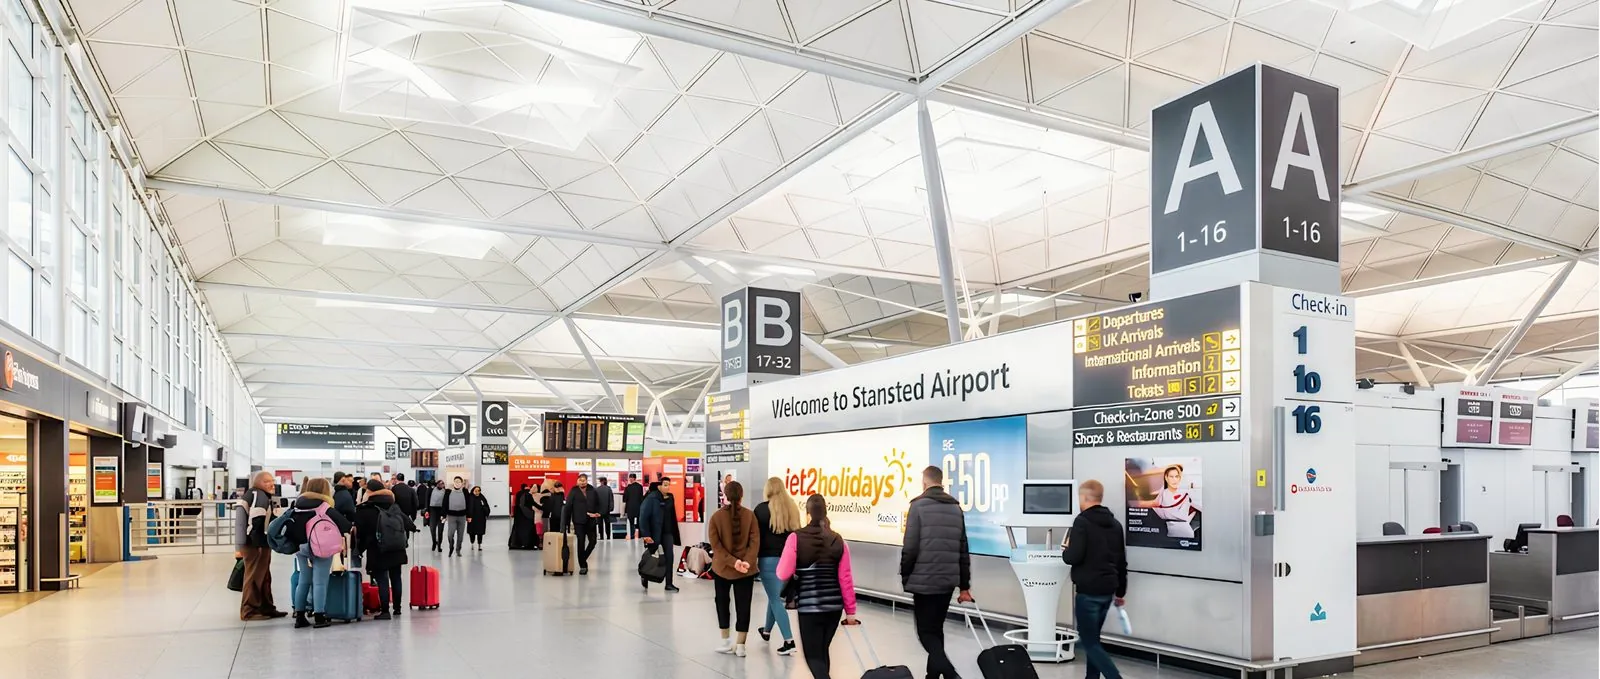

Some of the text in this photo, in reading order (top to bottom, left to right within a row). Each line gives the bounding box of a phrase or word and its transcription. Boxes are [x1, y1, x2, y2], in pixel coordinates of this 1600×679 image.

[1164, 100, 1243, 215] A
[1270, 91, 1331, 202] A
[1177, 219, 1227, 253] 1-16
[1282, 215, 1321, 244] 1-16
[1102, 306, 1164, 330] Departures
[1291, 293, 1348, 317] Check-in
[724, 298, 742, 350] B
[755, 295, 793, 347] B
[1103, 325, 1164, 347] UK Arrivals
[1293, 325, 1308, 355] 1
[756, 354, 792, 369] 17-32
[1084, 338, 1201, 368] International Arrivals
[1131, 359, 1201, 380] Information
[771, 363, 1010, 419] Welcome to Stansted Airport
[485, 403, 504, 425] C
[1177, 403, 1201, 418] 500
[1292, 405, 1322, 434] 16
[451, 418, 467, 435] D
[1074, 431, 1104, 447] Shops
[1106, 431, 1115, 442] &
[1116, 426, 1183, 443] Restaurants
[785, 466, 895, 506] jet2holidays
